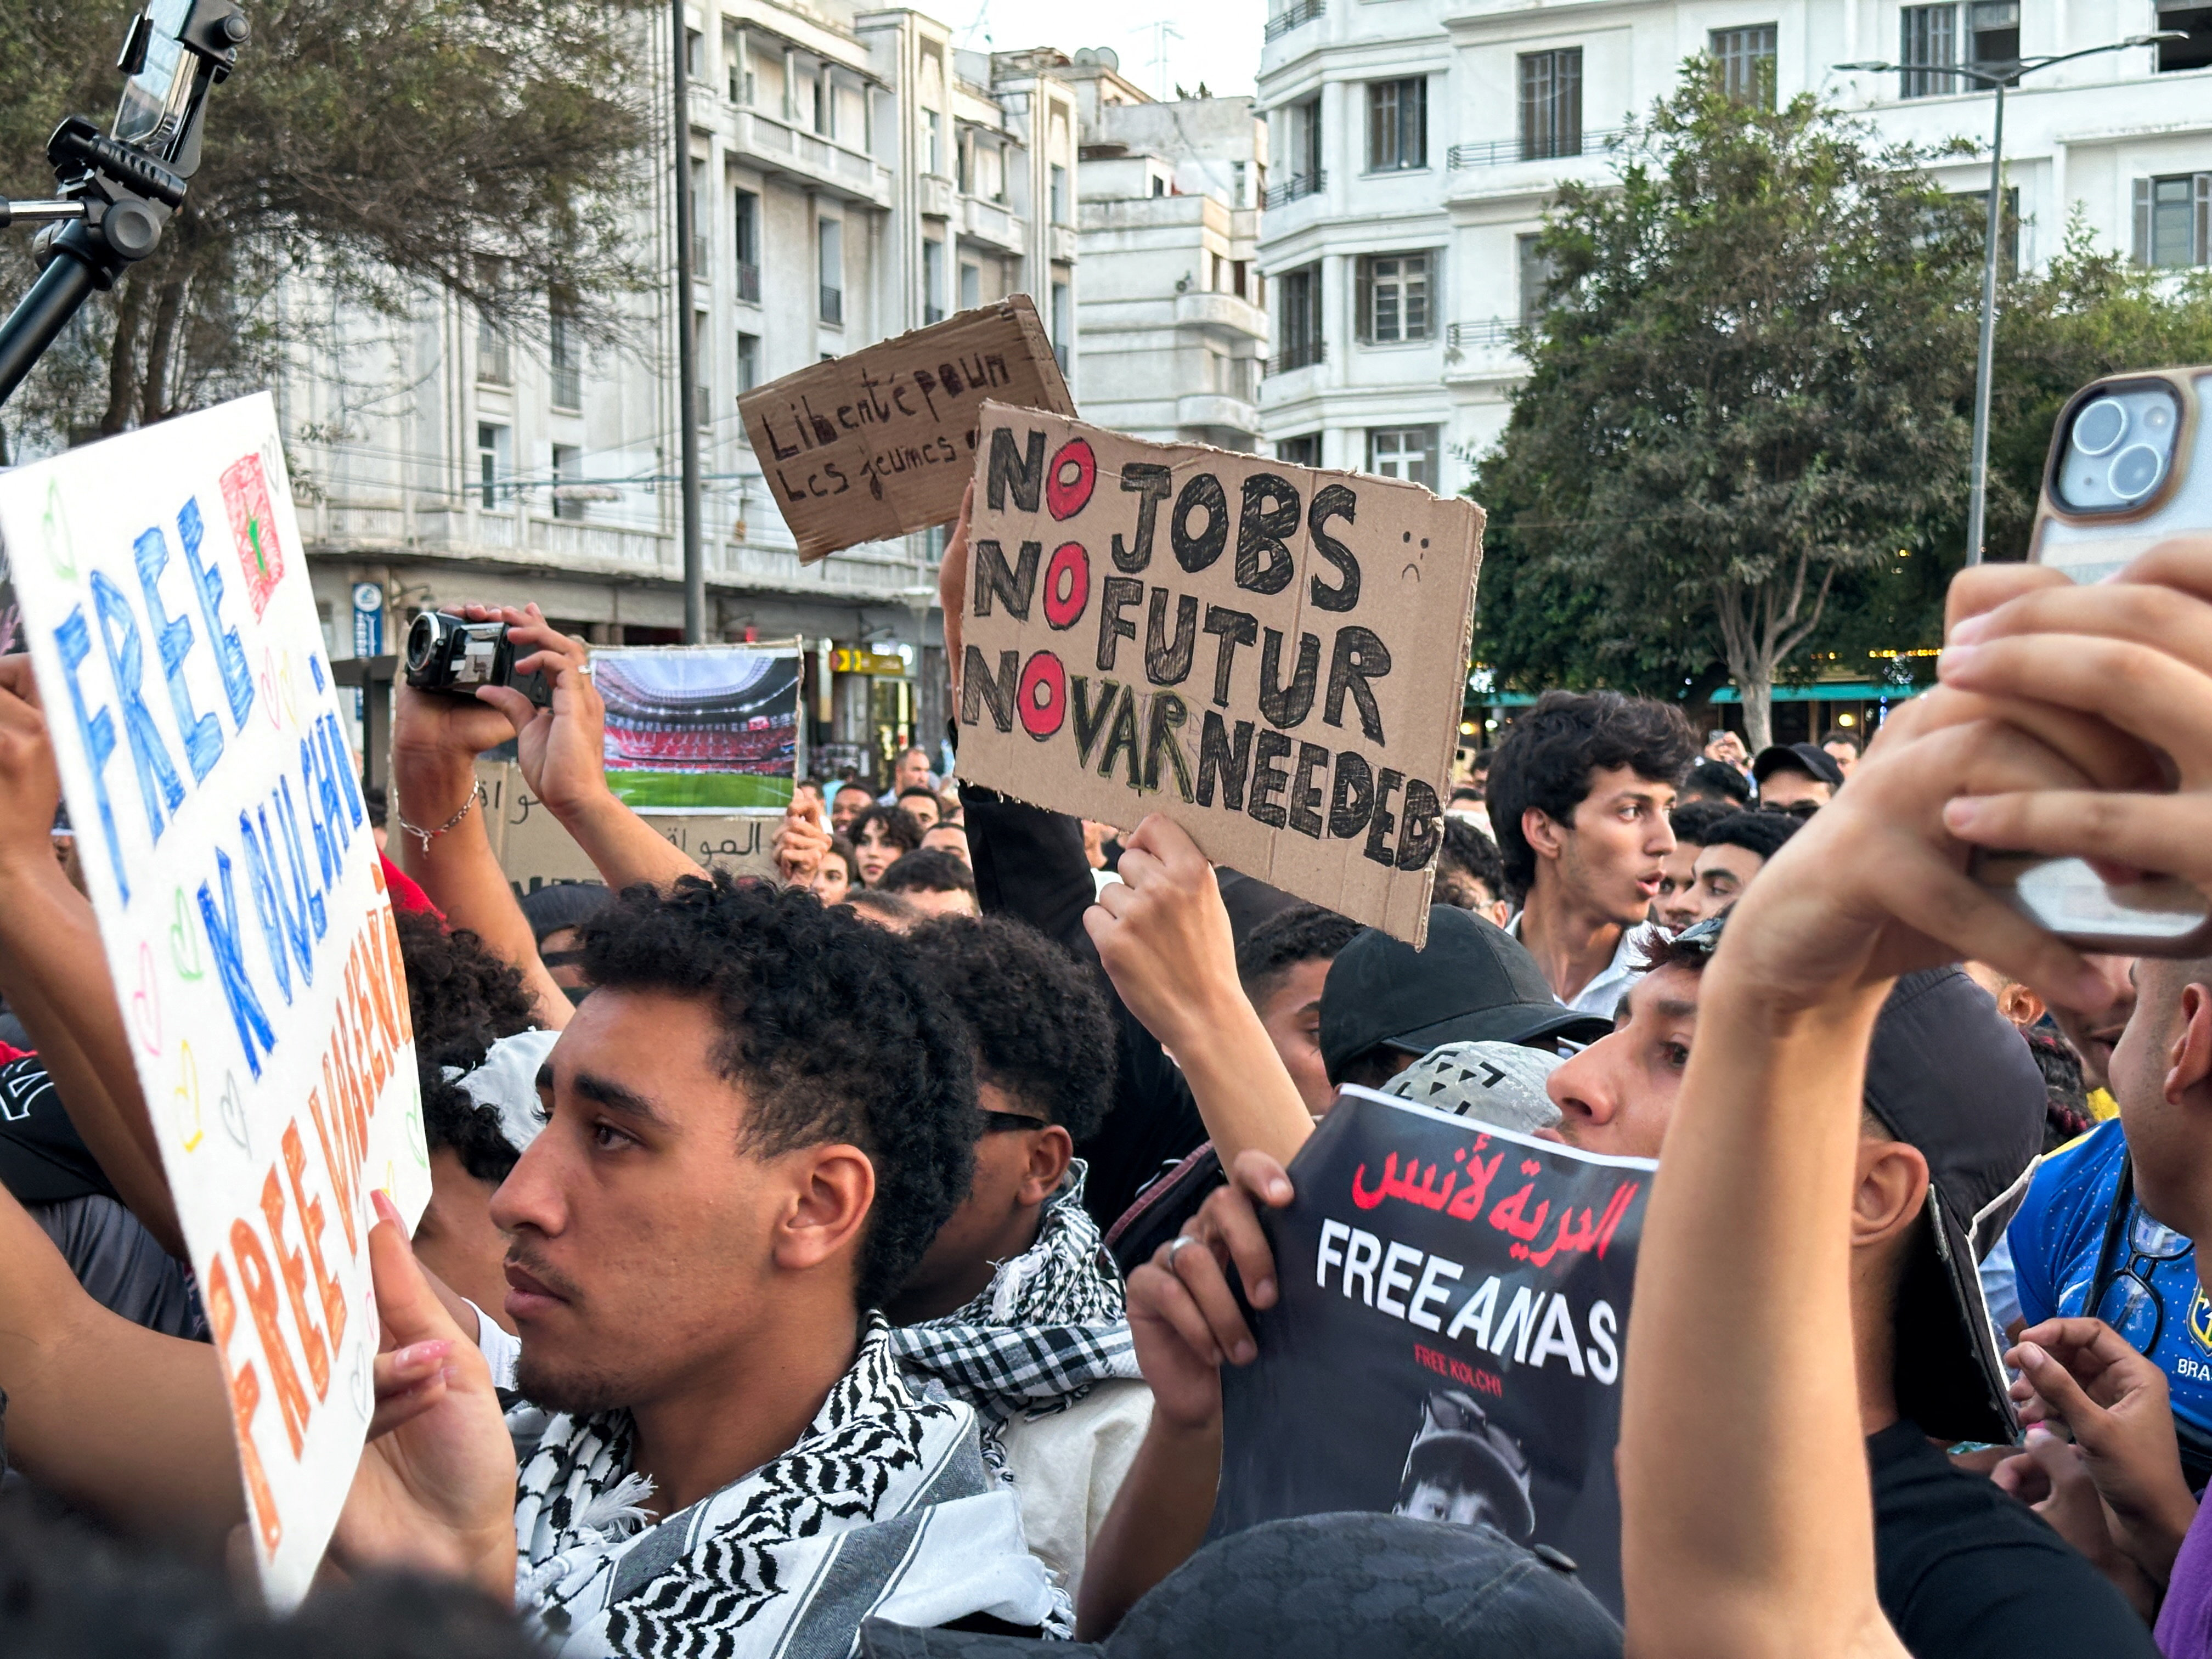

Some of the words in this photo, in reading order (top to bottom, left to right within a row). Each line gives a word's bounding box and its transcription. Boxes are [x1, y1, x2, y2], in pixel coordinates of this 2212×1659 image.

[988, 426, 1096, 522] NO
[1111, 462, 1361, 613] JOBS
[53, 495, 255, 912] FREE
[973, 539, 1090, 631] NO
[1096, 575, 1392, 747] FUTUR
[961, 644, 1067, 742] NO
[1070, 674, 1194, 804] VAR
[1195, 709, 1444, 871] NEEDED
[1352, 1133, 1505, 1222] لأنس
[208, 1116, 346, 1565] FREE
[1317, 1218, 1464, 1332] FREE
[1447, 1276, 1619, 1385] ANAS
[1414, 1342, 1448, 1377] FREE
[1449, 1359, 1503, 1398] KOLCHI
[2177, 1358, 2212, 1381] BRA
